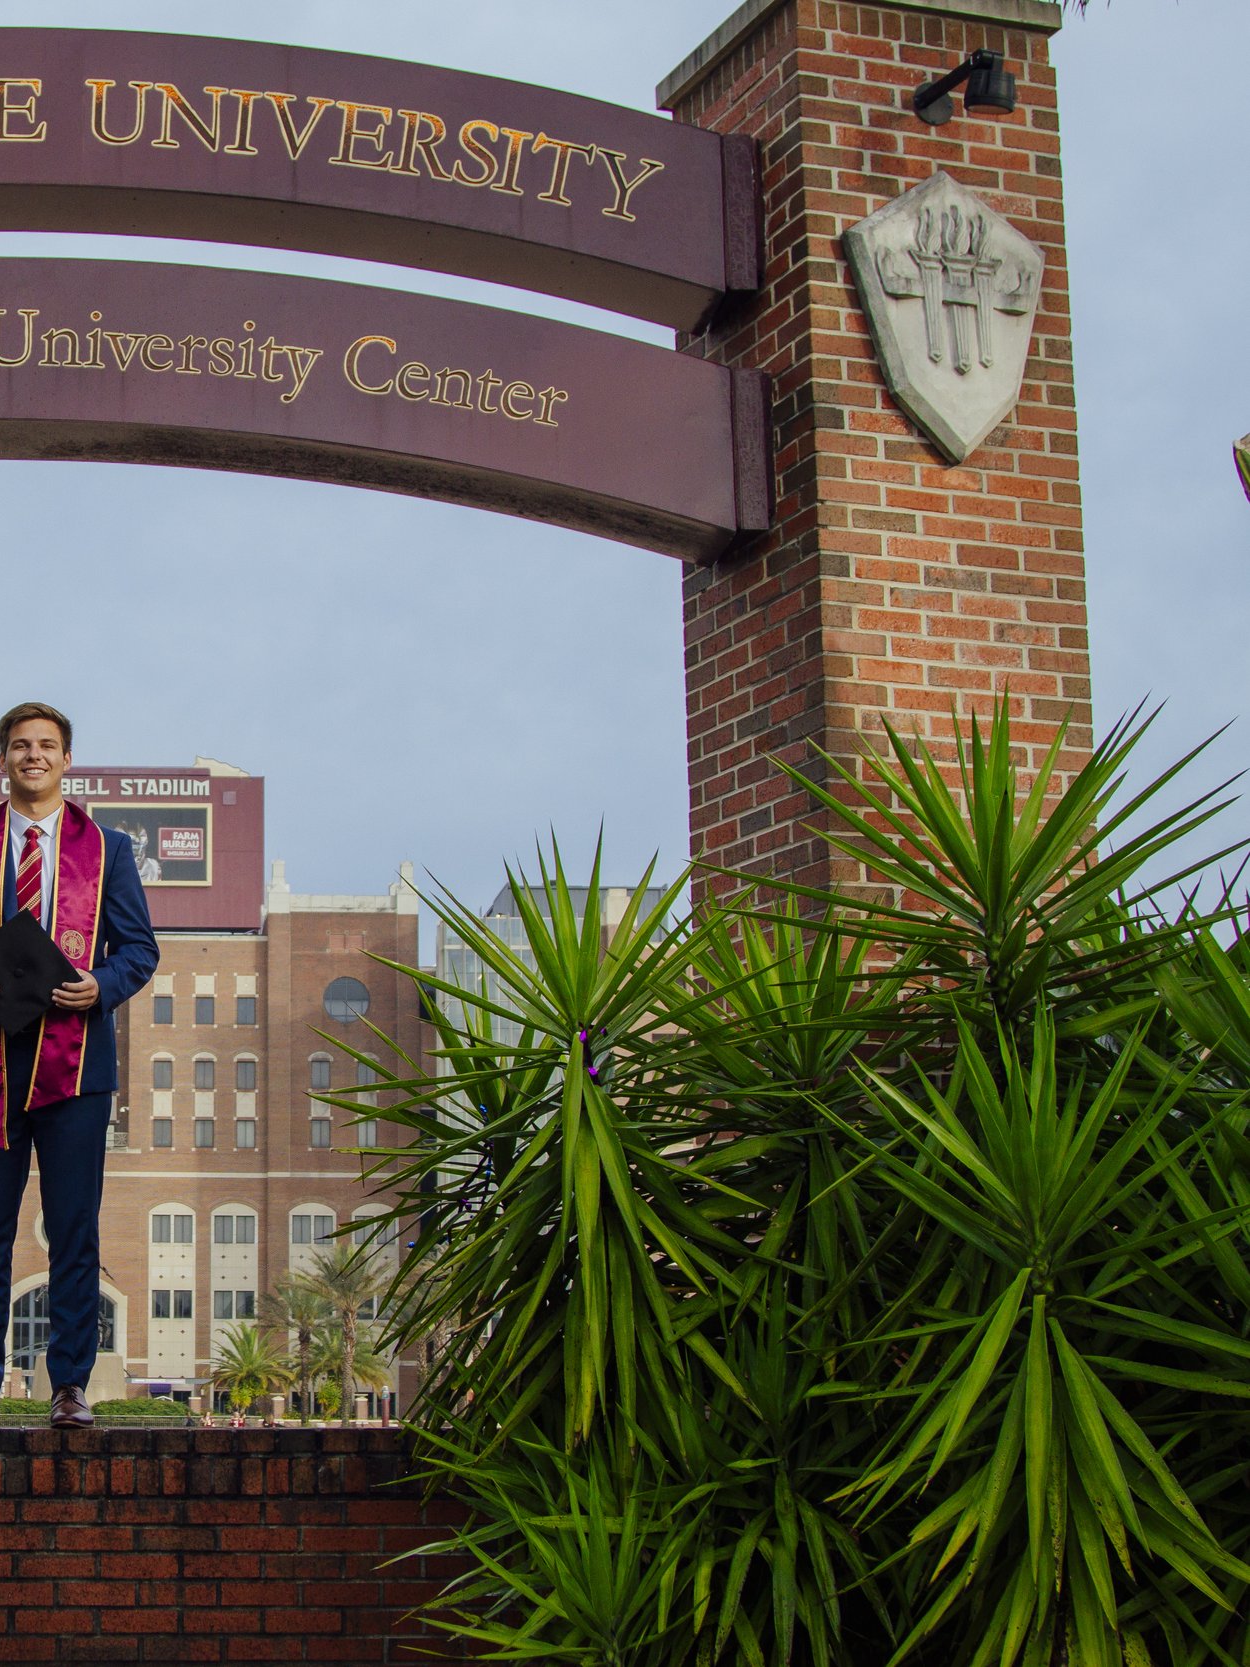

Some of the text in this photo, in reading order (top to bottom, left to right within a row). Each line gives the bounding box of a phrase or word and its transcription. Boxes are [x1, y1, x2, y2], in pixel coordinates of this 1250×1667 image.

[84, 78, 664, 222] UNIVERSITY
[343, 335, 568, 427] Center
[1, 777, 110, 795] CBELL
[120, 778, 210, 796] STADIUM
[162, 840, 200, 848] BUREAU
[173, 831, 199, 840] FARM
